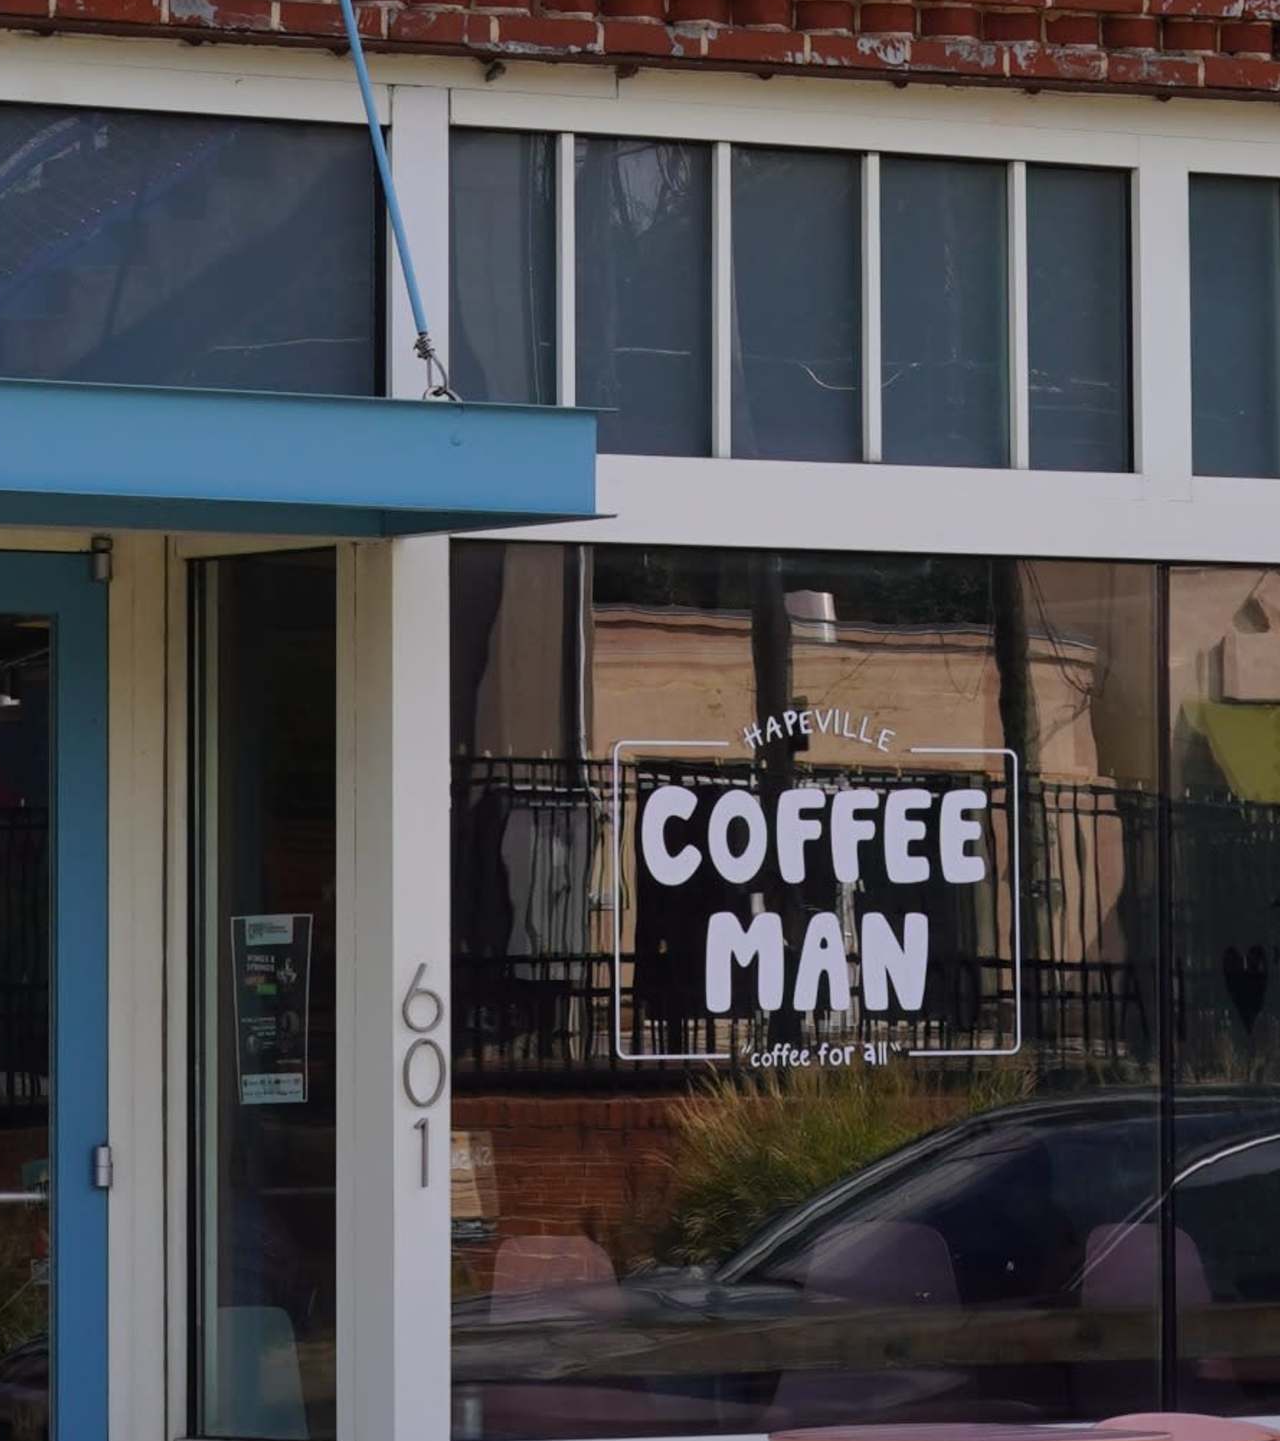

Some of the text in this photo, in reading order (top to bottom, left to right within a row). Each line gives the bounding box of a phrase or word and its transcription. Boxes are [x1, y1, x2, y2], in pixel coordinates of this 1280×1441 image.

[743, 708, 897, 753] HAPEVILLE
[641, 786, 988, 886] COFFEE
[705, 912, 929, 1013] MAN
[402, 962, 447, 1188] 601
[818, 1042, 856, 1067] for
